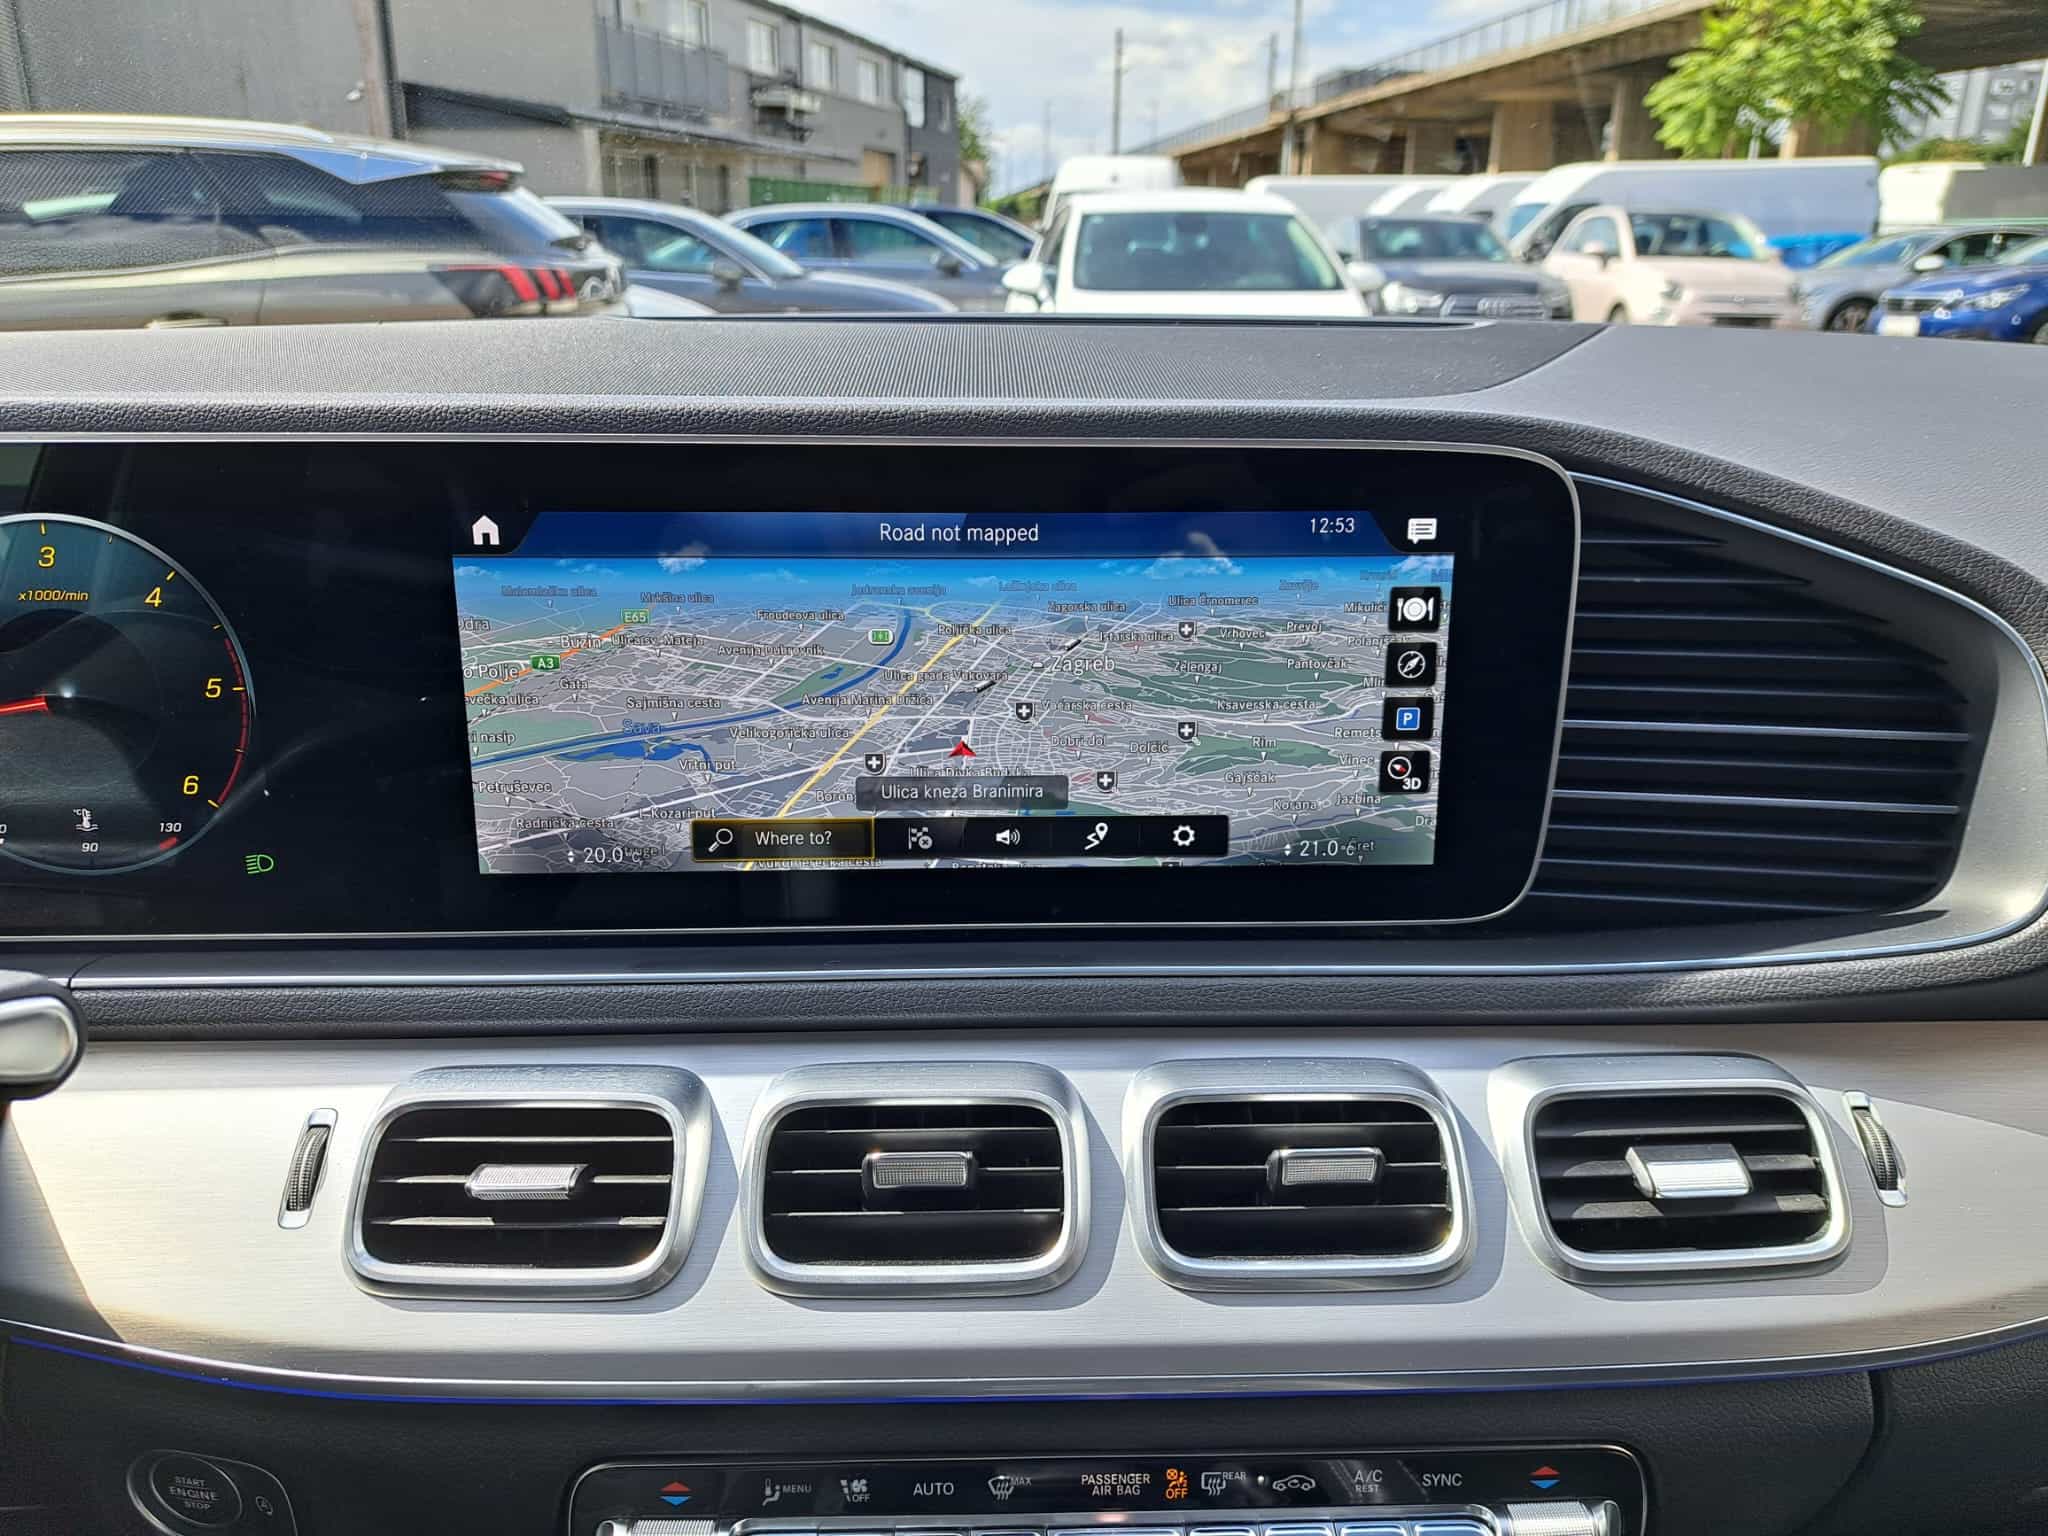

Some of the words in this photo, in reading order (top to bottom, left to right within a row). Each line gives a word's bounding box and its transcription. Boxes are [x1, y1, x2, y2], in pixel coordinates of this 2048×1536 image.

[1310, 517, 1355, 534] 12:53
[880, 523, 925, 542] Road
[931, 524, 961, 542] not
[967, 523, 1039, 546] mapped
[38, 545, 55, 568] 3
[18, 590, 89, 602] x1000/min
[145, 586, 162, 608] 4
[1168, 594, 1196, 606] Ulica
[1100, 601, 1127, 612] ulica
[624, 611, 647, 623] E65
[818, 610, 846, 621] ulica
[985, 624, 1013, 636] ulica
[1220, 628, 1266, 639] Vrhovec
[1287, 621, 1322, 634] Prevoj
[561, 635, 601, 649] Buzin
[718, 645, 761, 658] Avenija
[538, 656, 554, 668] A3
[1052, 656, 1115, 675] Zagreb
[1287, 657, 1346, 669] Pantovčak
[479, 665, 518, 681] Polje
[205, 678, 223, 698] 5
[509, 695, 540, 706] ulica
[687, 698, 722, 708] cesta
[802, 693, 847, 707] Avenija
[852, 693, 894, 706] Marina
[1101, 701, 1133, 711] cesta
[1217, 699, 1280, 710] Ksaverska
[1284, 700, 1317, 710] cesta
[623, 719, 663, 734] Sava
[480, 731, 515, 745] nasip
[820, 727, 849, 739] ulica
[1088, 735, 1106, 746] dol
[1252, 736, 1277, 748] Rim
[715, 759, 737, 773] put
[183, 774, 200, 795] 6
[479, 780, 552, 793] Petruševec
[1402, 778, 1421, 790] 3D
[881, 784, 918, 799] Ulica
[924, 783, 967, 799] kneza
[973, 783, 1044, 799] Branimira
[1336, 793, 1382, 806] Jazbina
[695, 807, 718, 820] put
[159, 822, 182, 833] 130
[579, 818, 615, 829] cesta
[755, 831, 805, 845] Where
[809, 831, 832, 845] to?
[81, 842, 99, 853] 90
[1300, 839, 1338, 857] 21.0
[583, 847, 624, 863] 20.0
[1010, 1476, 1032, 1487] MAX
[1081, 1473, 1151, 1485] PASSENGER
[1222, 1471, 1247, 1481] REAR
[1353, 1469, 1383, 1484] A/C
[1422, 1473, 1463, 1487] SYNC
[168, 1485, 219, 1502] ENGINE
[782, 1484, 812, 1494] MENU
[913, 1482, 955, 1496] AUTO
[1092, 1485, 1112, 1496] AIR
[1116, 1485, 1141, 1496] BAG
[1165, 1488, 1189, 1500] OFF
[1355, 1484, 1380, 1493] REST
[852, 1494, 871, 1503] OFF
